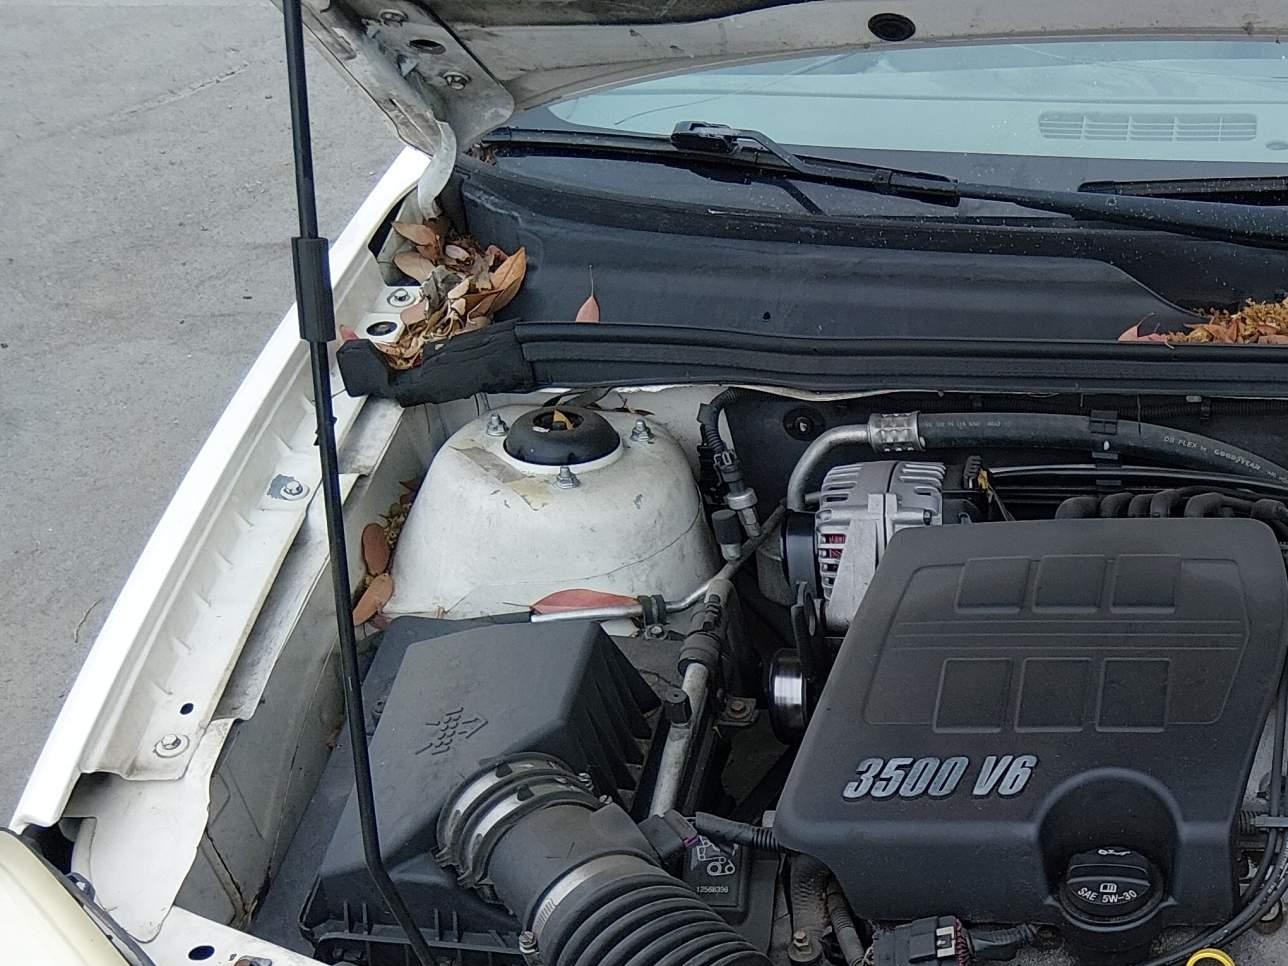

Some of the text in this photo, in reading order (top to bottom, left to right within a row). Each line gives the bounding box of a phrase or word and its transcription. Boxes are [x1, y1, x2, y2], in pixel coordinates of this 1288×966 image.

[843, 755, 1037, 798] 3500 V6
[1077, 887, 1137, 903] SAE 5W-30
